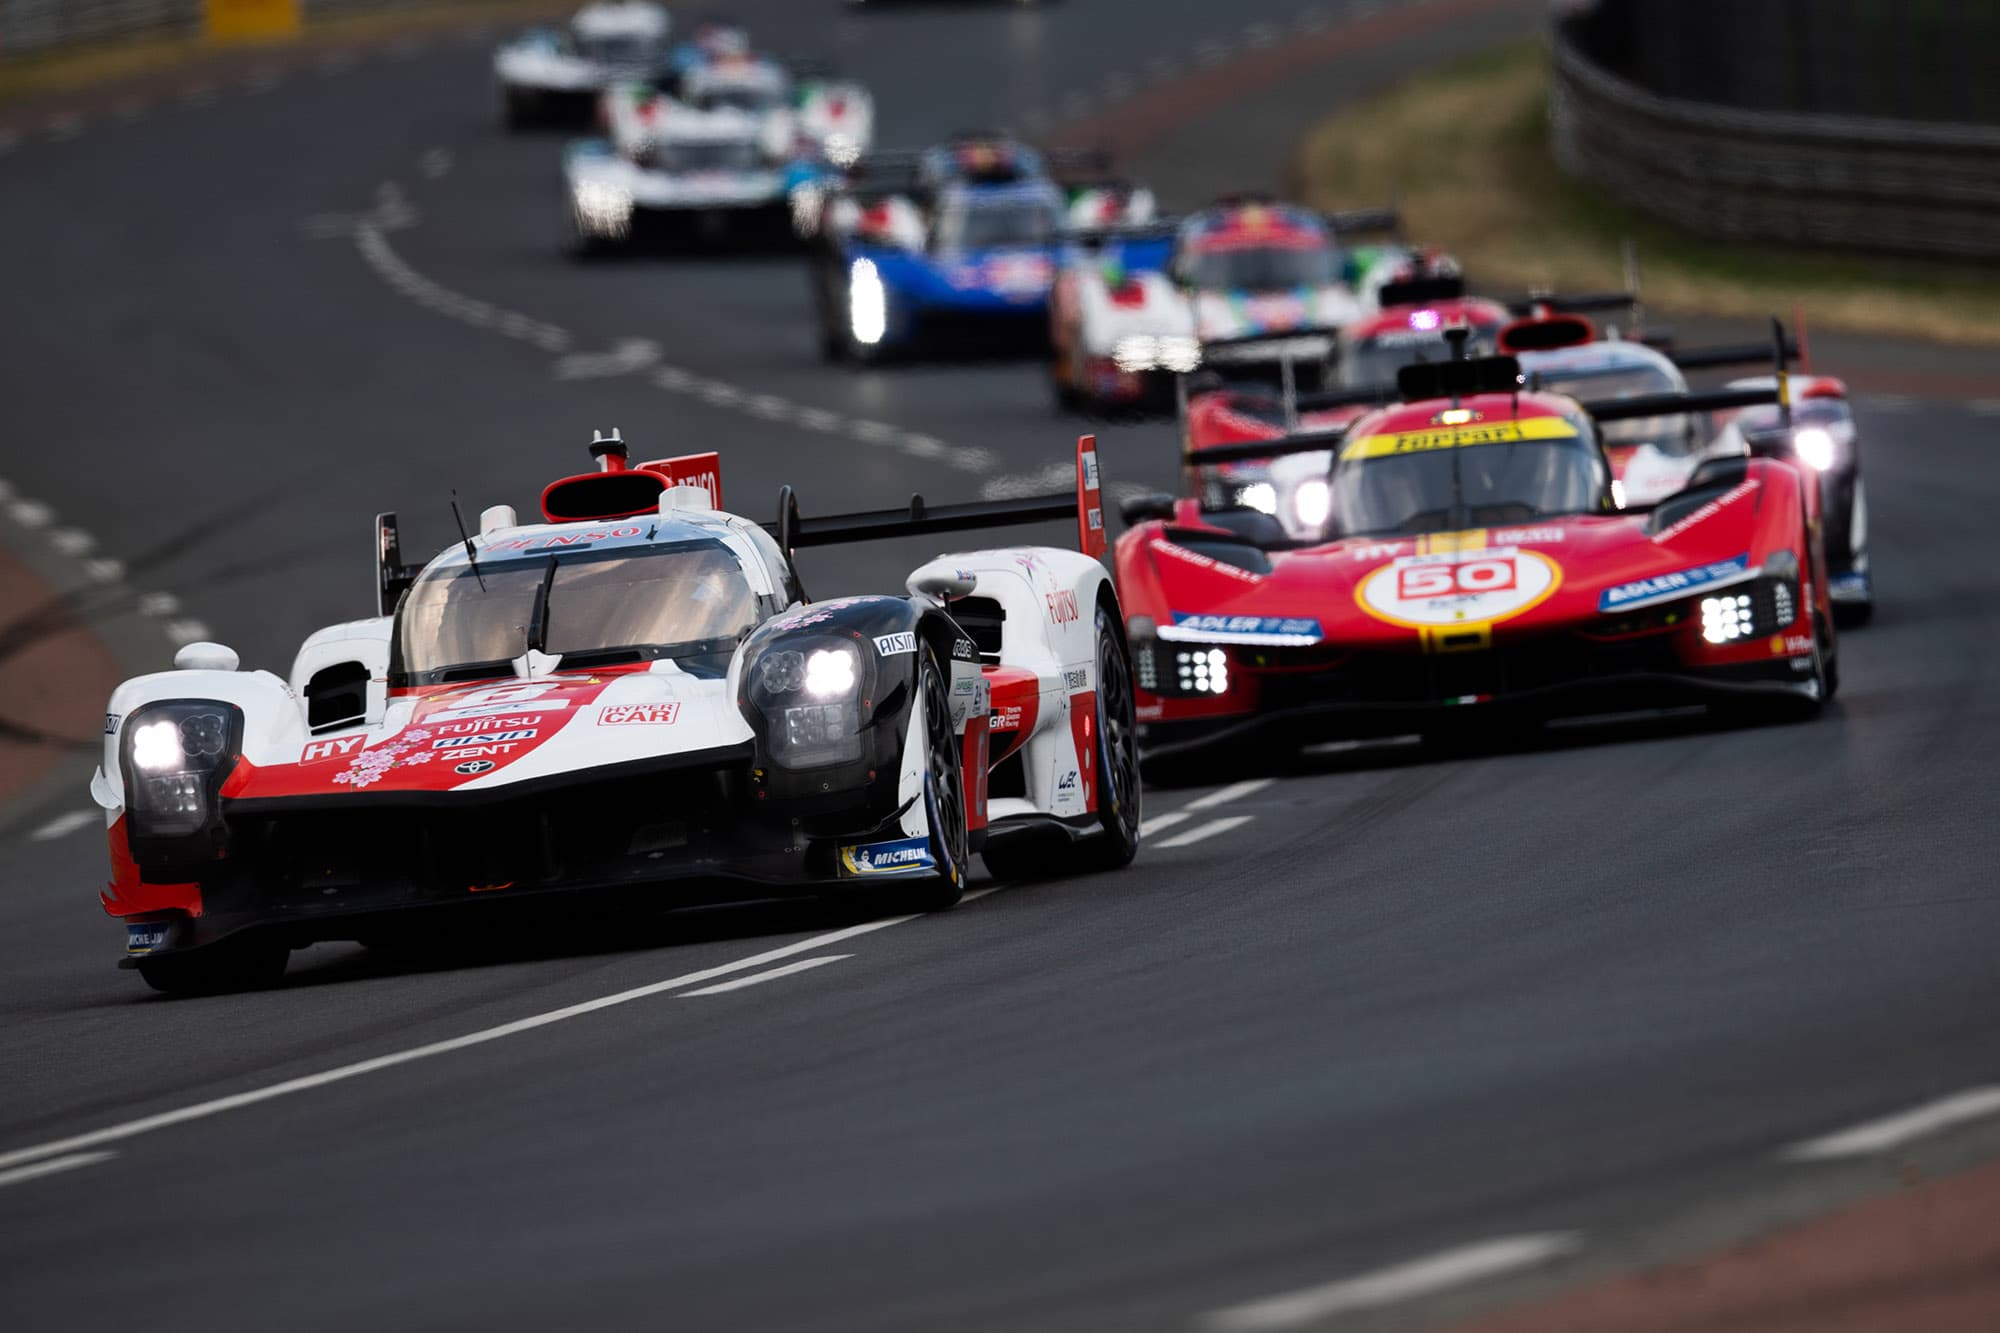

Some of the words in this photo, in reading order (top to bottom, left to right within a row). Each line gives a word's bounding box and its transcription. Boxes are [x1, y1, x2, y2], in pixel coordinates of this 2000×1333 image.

[486, 527, 641, 551] DENSO
[1403, 562, 1513, 597] 50
[1608, 573, 1688, 602] ADLER
[1046, 589, 1079, 633] FUJITSU
[1176, 616, 1261, 632] ADLER
[880, 634, 917, 654] AISIN
[604, 710, 671, 723] CAR
[607, 704, 673, 714] HYPER
[437, 716, 543, 735] FUJITSU
[989, 715, 1005, 728] GR
[435, 730, 536, 748] AISIN
[305, 737, 363, 761] HY
[440, 743, 518, 760] ZENT
[874, 847, 927, 865] MICHELIN
